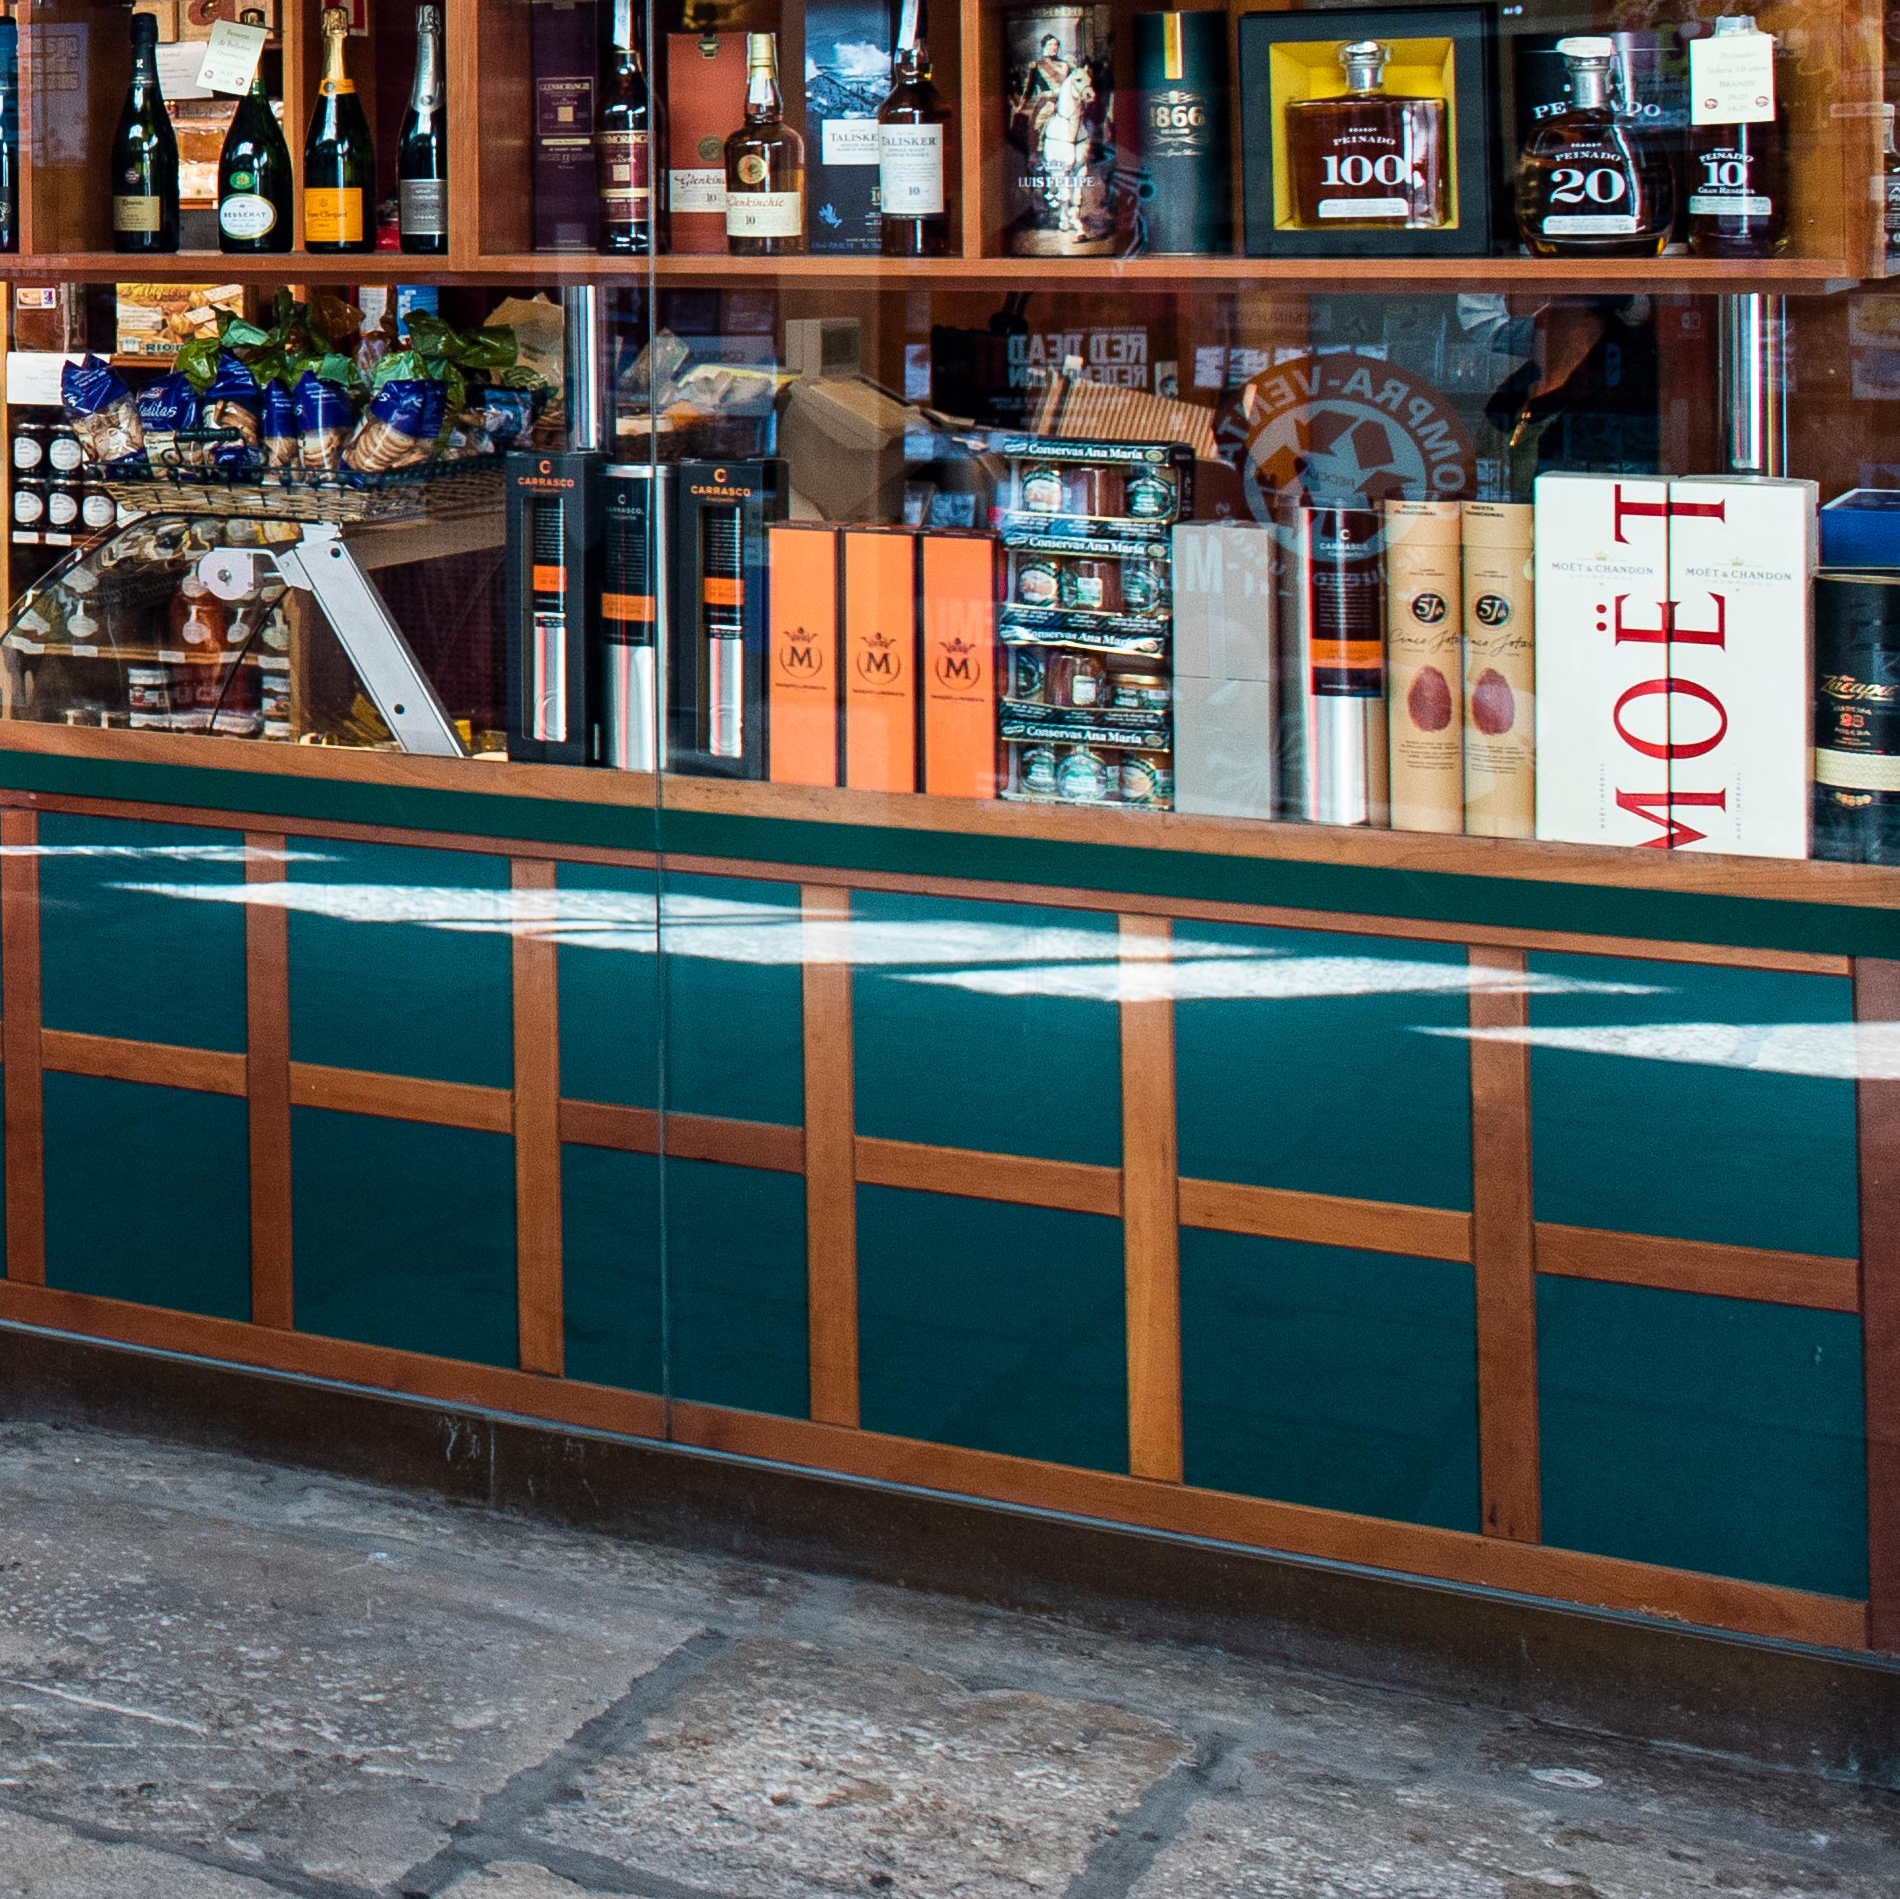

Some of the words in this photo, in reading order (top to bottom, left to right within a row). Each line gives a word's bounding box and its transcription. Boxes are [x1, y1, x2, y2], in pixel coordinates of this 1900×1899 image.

[1150, 106, 1205, 129] 1866
[881, 135, 937, 147] TALISKER
[1333, 134, 1397, 147] PEINADO
[1554, 150, 1623, 163] PEINADO
[1699, 152, 1755, 164] PEINADO
[1321, 154, 1404, 186] 100
[1702, 161, 1748, 187] 10
[908, 186, 920, 196] 10
[1018, 176, 1044, 188] LUIS
[1046, 176, 1096, 189] FELIPE
[1550, 167, 1626, 203] 20
[223, 211, 267, 220] BESSERAT
[745, 215, 756, 225] 10
[1029, 443, 1084, 457] Conservas
[1085, 447, 1108, 458] Ana
[1109, 448, 1144, 461] María
[539, 459, 552, 476] C
[712, 467, 728, 484] C
[517, 475, 576, 489] CARRASCO
[690, 484, 752, 498] CARRASCO
[1029, 537, 1084, 551] Conservas
[1085, 541, 1108, 552] Ana
[1109, 542, 1144, 555] María
[1551, 559, 1583, 574] MOËT
[1585, 564, 1593, 574] &
[1594, 562, 1654, 576] CHANDON
[1685, 564, 1720, 579] MOËT
[1721, 568, 1729, 579] &
[1729, 566, 1792, 582] CHANDON
[1028, 629, 1077, 641] onservas
[1078, 632, 1102, 643] Ana
[788, 646, 814, 669] M
[866, 651, 892, 674] M
[945, 656, 972, 680] M
[1595, 484, 1729, 850] MOËT
[1027, 725, 1082, 739] Conservas
[1083, 729, 1106, 740] Ana
[1107, 730, 1142, 743] María
